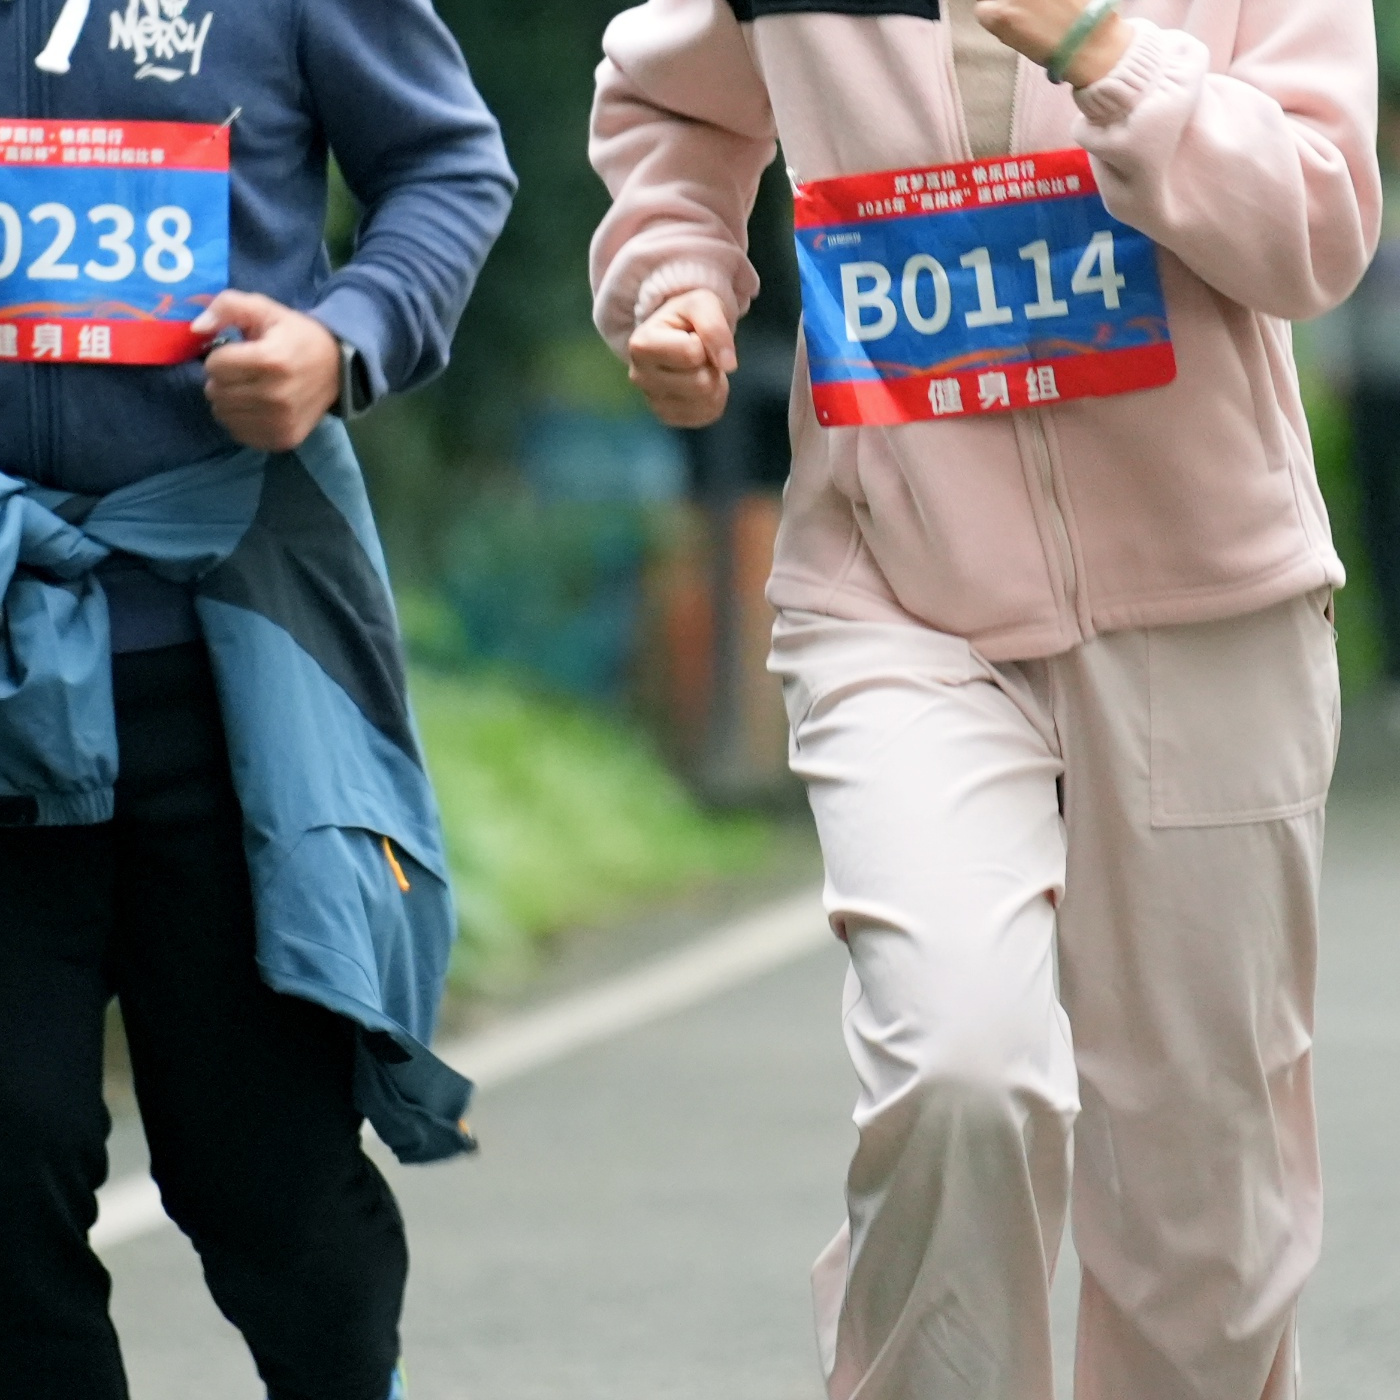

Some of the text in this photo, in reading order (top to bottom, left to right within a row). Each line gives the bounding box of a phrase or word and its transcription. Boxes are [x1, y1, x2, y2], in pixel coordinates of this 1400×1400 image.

[839, 229, 1126, 343] B0114
[927, 364, 1060, 416] 健身组
